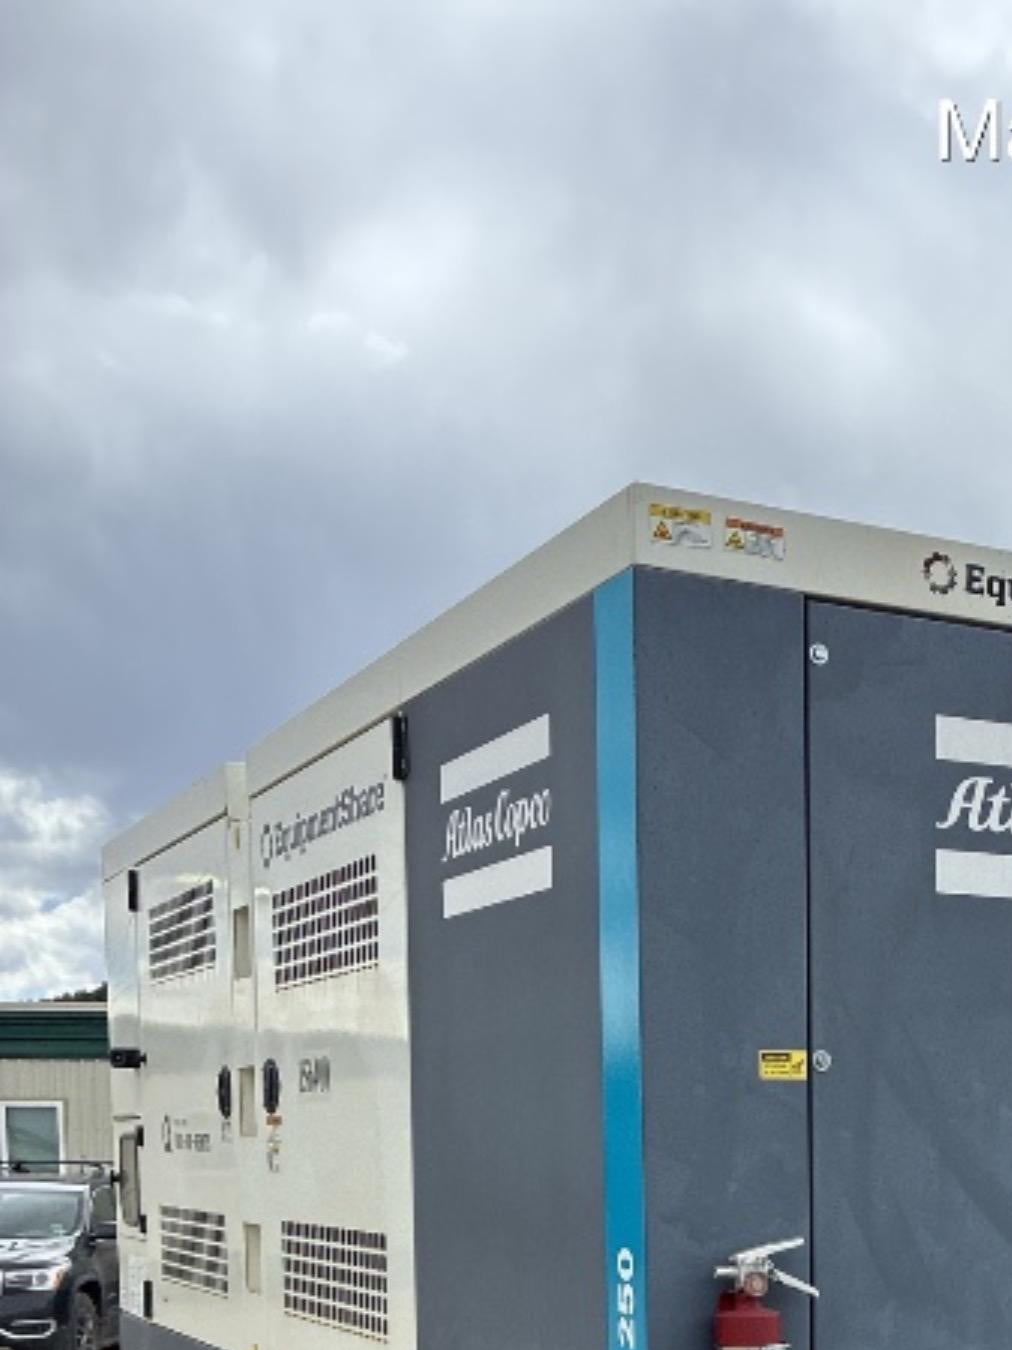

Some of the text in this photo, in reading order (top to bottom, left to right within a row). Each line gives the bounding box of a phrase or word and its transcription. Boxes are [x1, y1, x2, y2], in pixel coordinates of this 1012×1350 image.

[440, 788, 552, 862] Atlas Copco
[616, 1247, 635, 1350] 250
